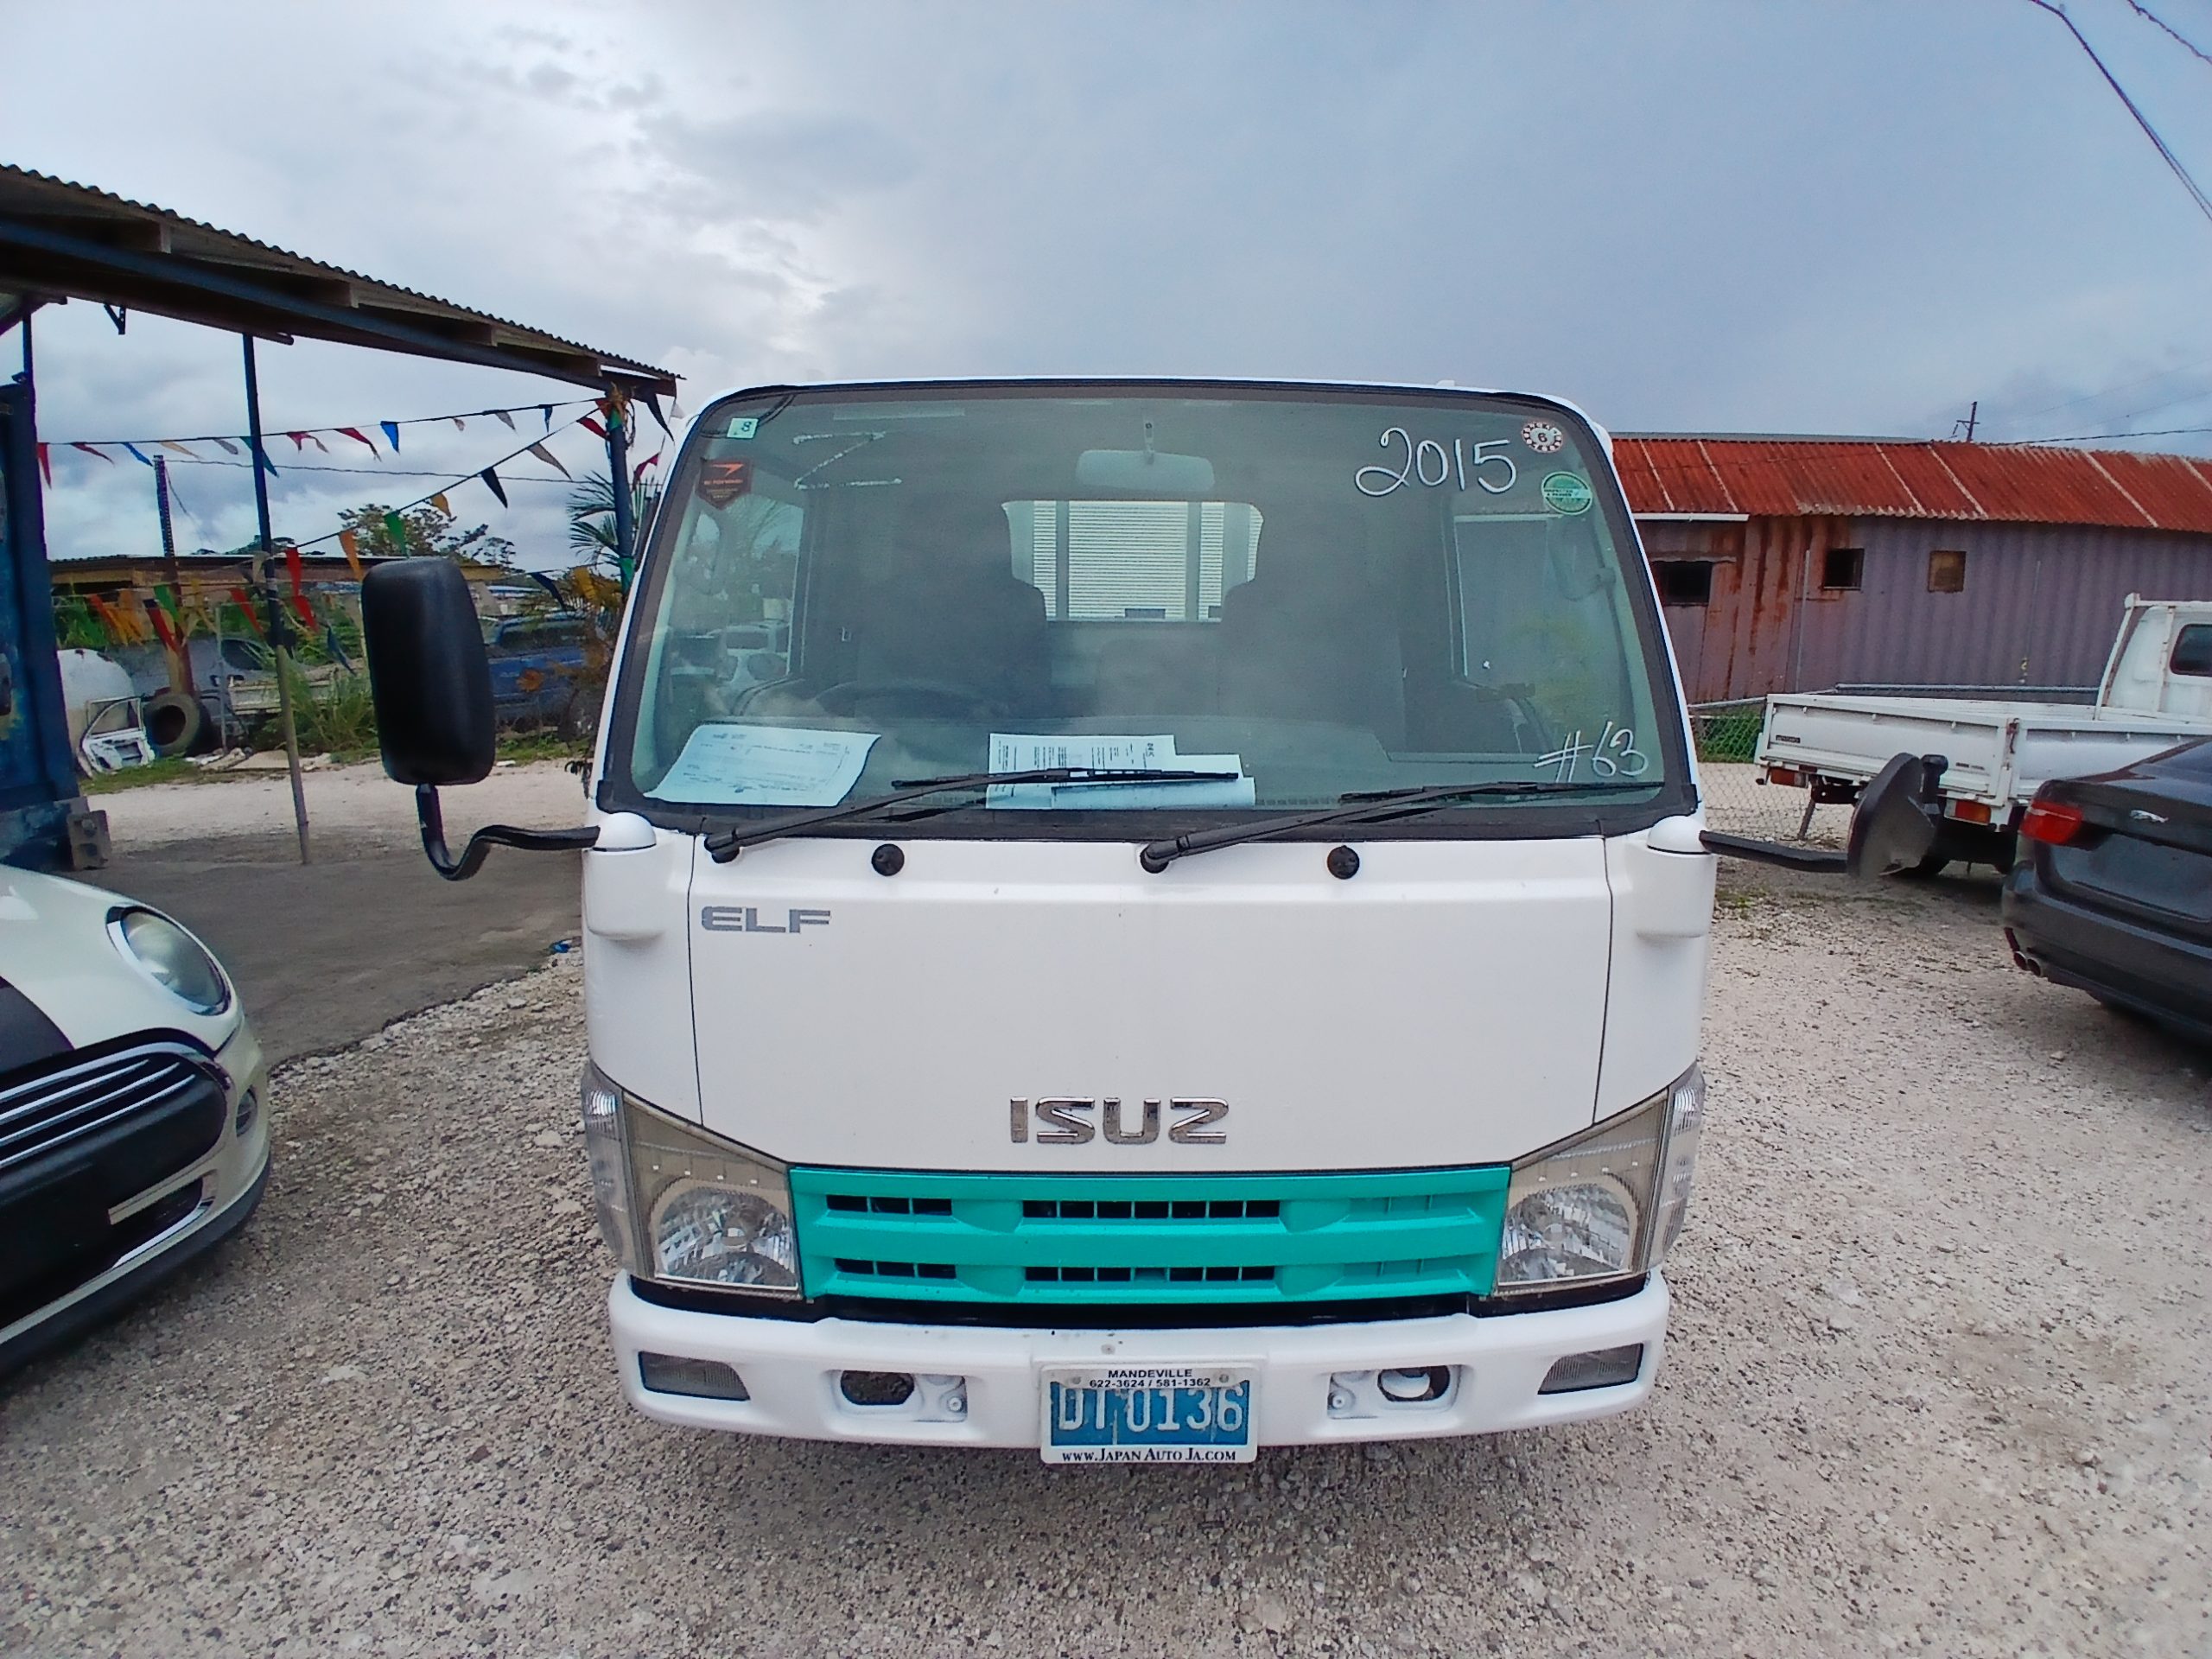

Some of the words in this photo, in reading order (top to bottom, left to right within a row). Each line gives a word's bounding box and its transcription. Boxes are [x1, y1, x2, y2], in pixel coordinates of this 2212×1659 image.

[1355, 427, 1516, 497] 2015
[1533, 721, 1649, 782] #63
[701, 906, 831, 933] ELF
[1009, 1096, 1229, 1145] ISUZ
[1108, 1369, 1192, 1378] MANDEVILLE
